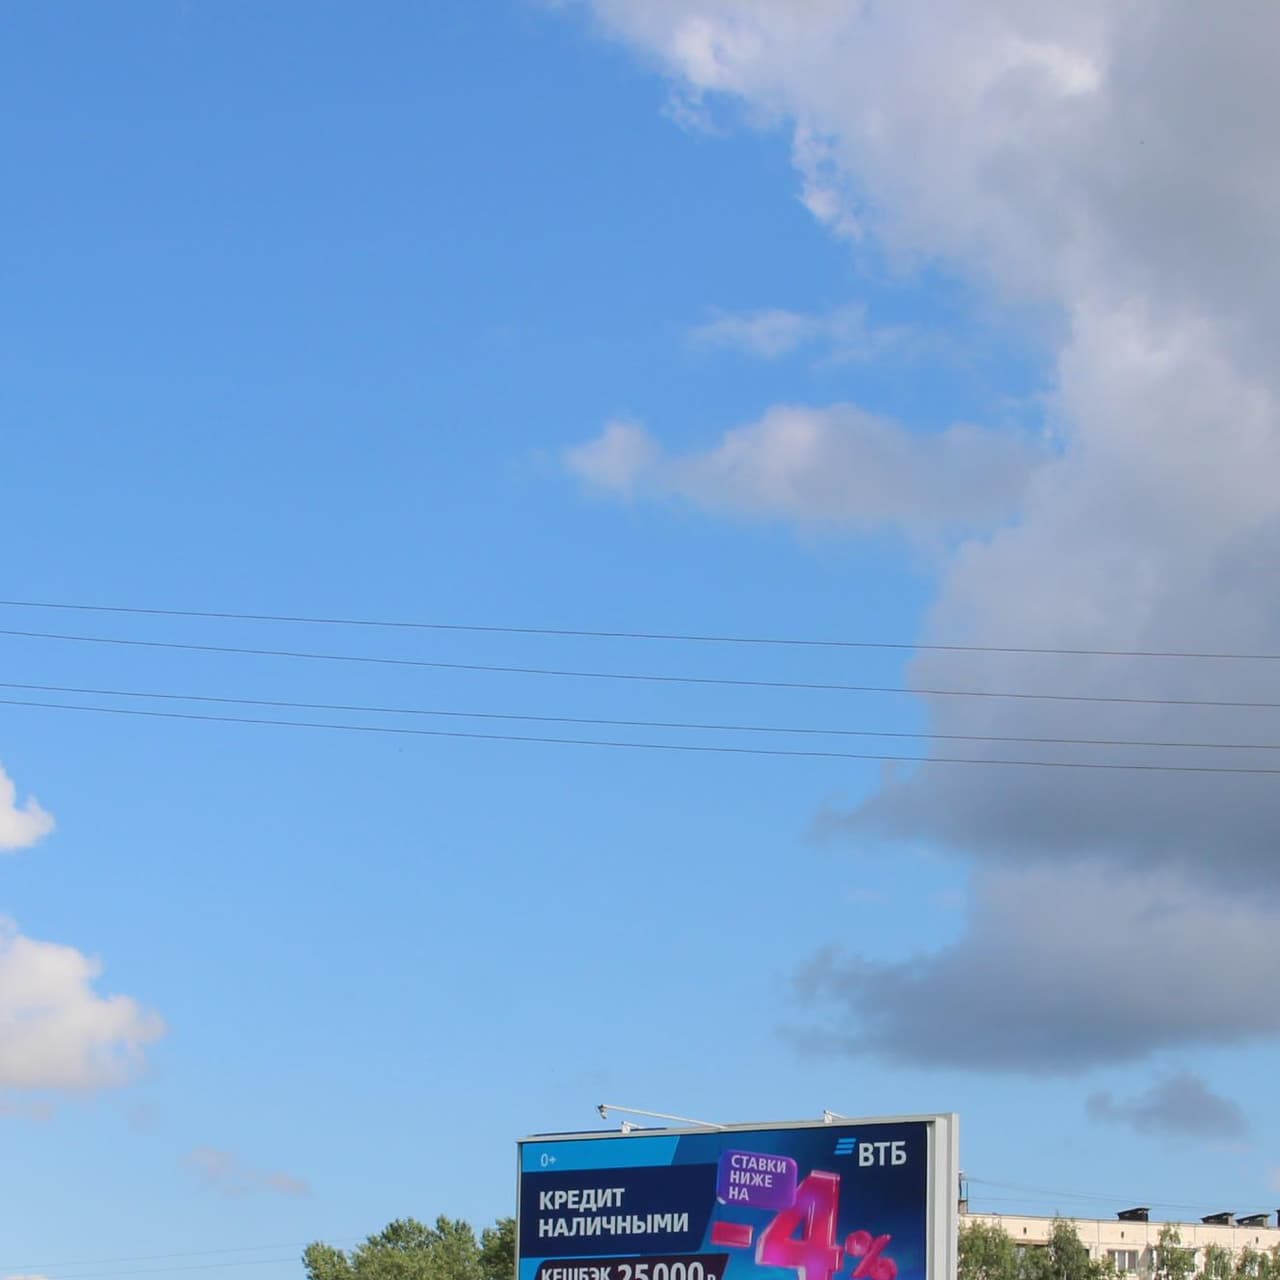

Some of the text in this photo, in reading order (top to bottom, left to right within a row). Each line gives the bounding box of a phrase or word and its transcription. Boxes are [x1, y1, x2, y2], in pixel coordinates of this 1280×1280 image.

[540, 1153, 557, 1167] 0+
[858, 1140, 907, 1167] ВТБ
[731, 1154, 787, 1173] СТАВКИ
[729, 1170, 773, 1188] НИЖЕ
[539, 1188, 625, 1213] КРЕДИТ
[728, 1186, 749, 1201] НА
[538, 1213, 689, 1238] НАЛИЧНЫМИ
